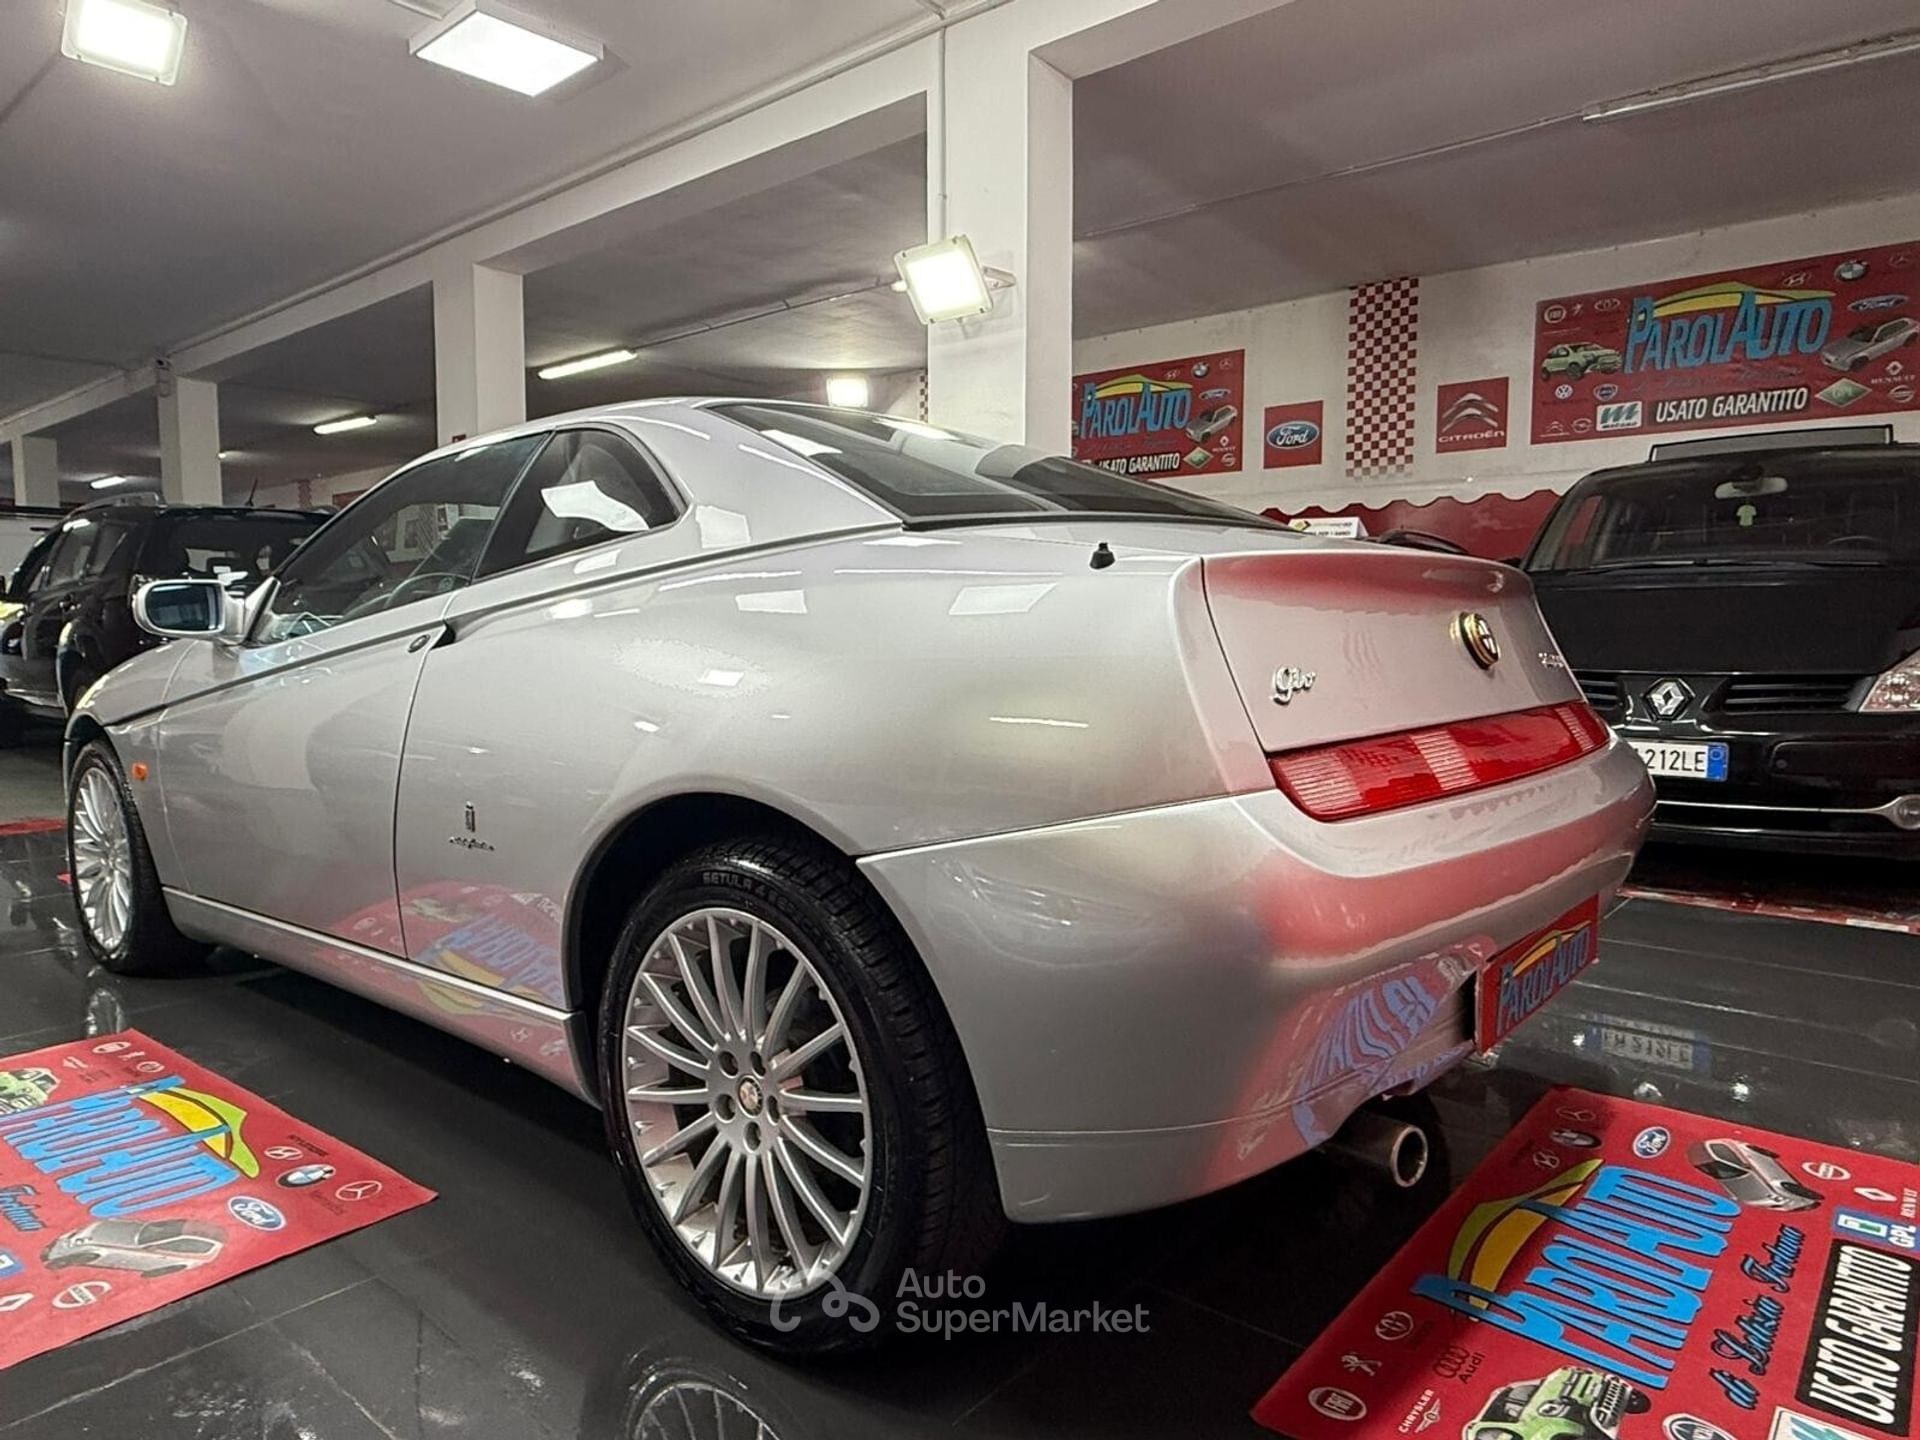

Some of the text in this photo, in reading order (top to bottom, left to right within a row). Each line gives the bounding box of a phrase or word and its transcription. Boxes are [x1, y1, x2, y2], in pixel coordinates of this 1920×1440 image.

[1656, 387, 1809, 422] USATO GARANTITO
[1276, 426, 1310, 445] Ford
[1128, 453, 1181, 473] GARANTITO
[1888, 1223, 1917, 1248] GPL
[1809, 1244, 1913, 1424] USATO GARANTITO
[1458, 1351, 1486, 1384] Audi
